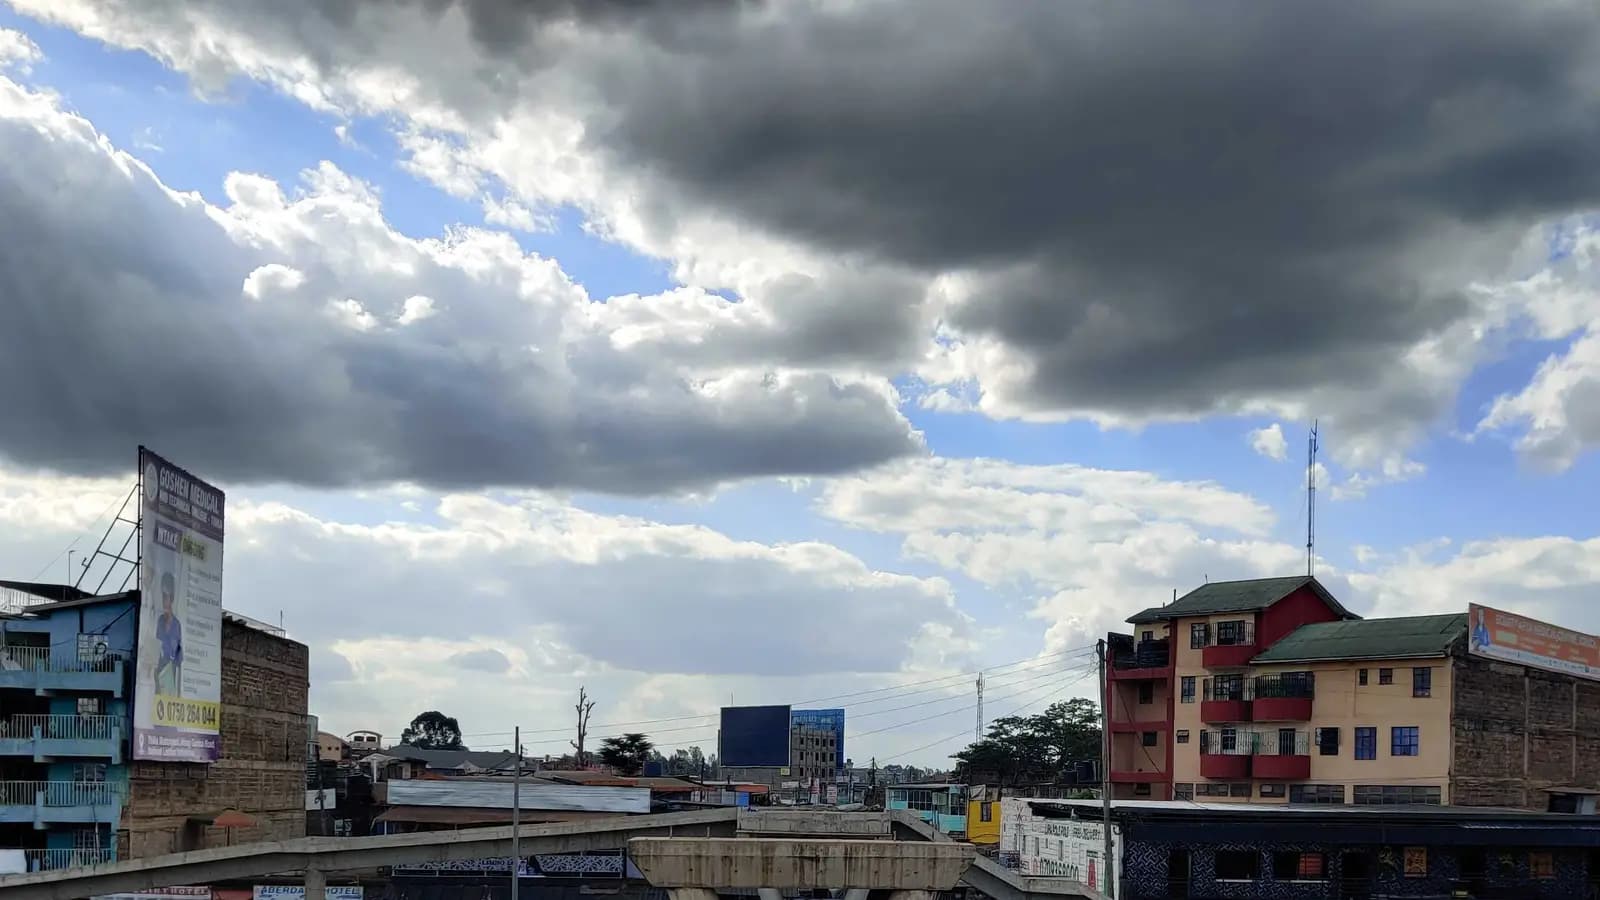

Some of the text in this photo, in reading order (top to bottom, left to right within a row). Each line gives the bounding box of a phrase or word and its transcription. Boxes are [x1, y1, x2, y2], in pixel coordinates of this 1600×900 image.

[160, 467, 219, 514] GOSHEN MEDICAL
[202, 706, 216, 726] 044
[261, 886, 305, 895] ABERDA
